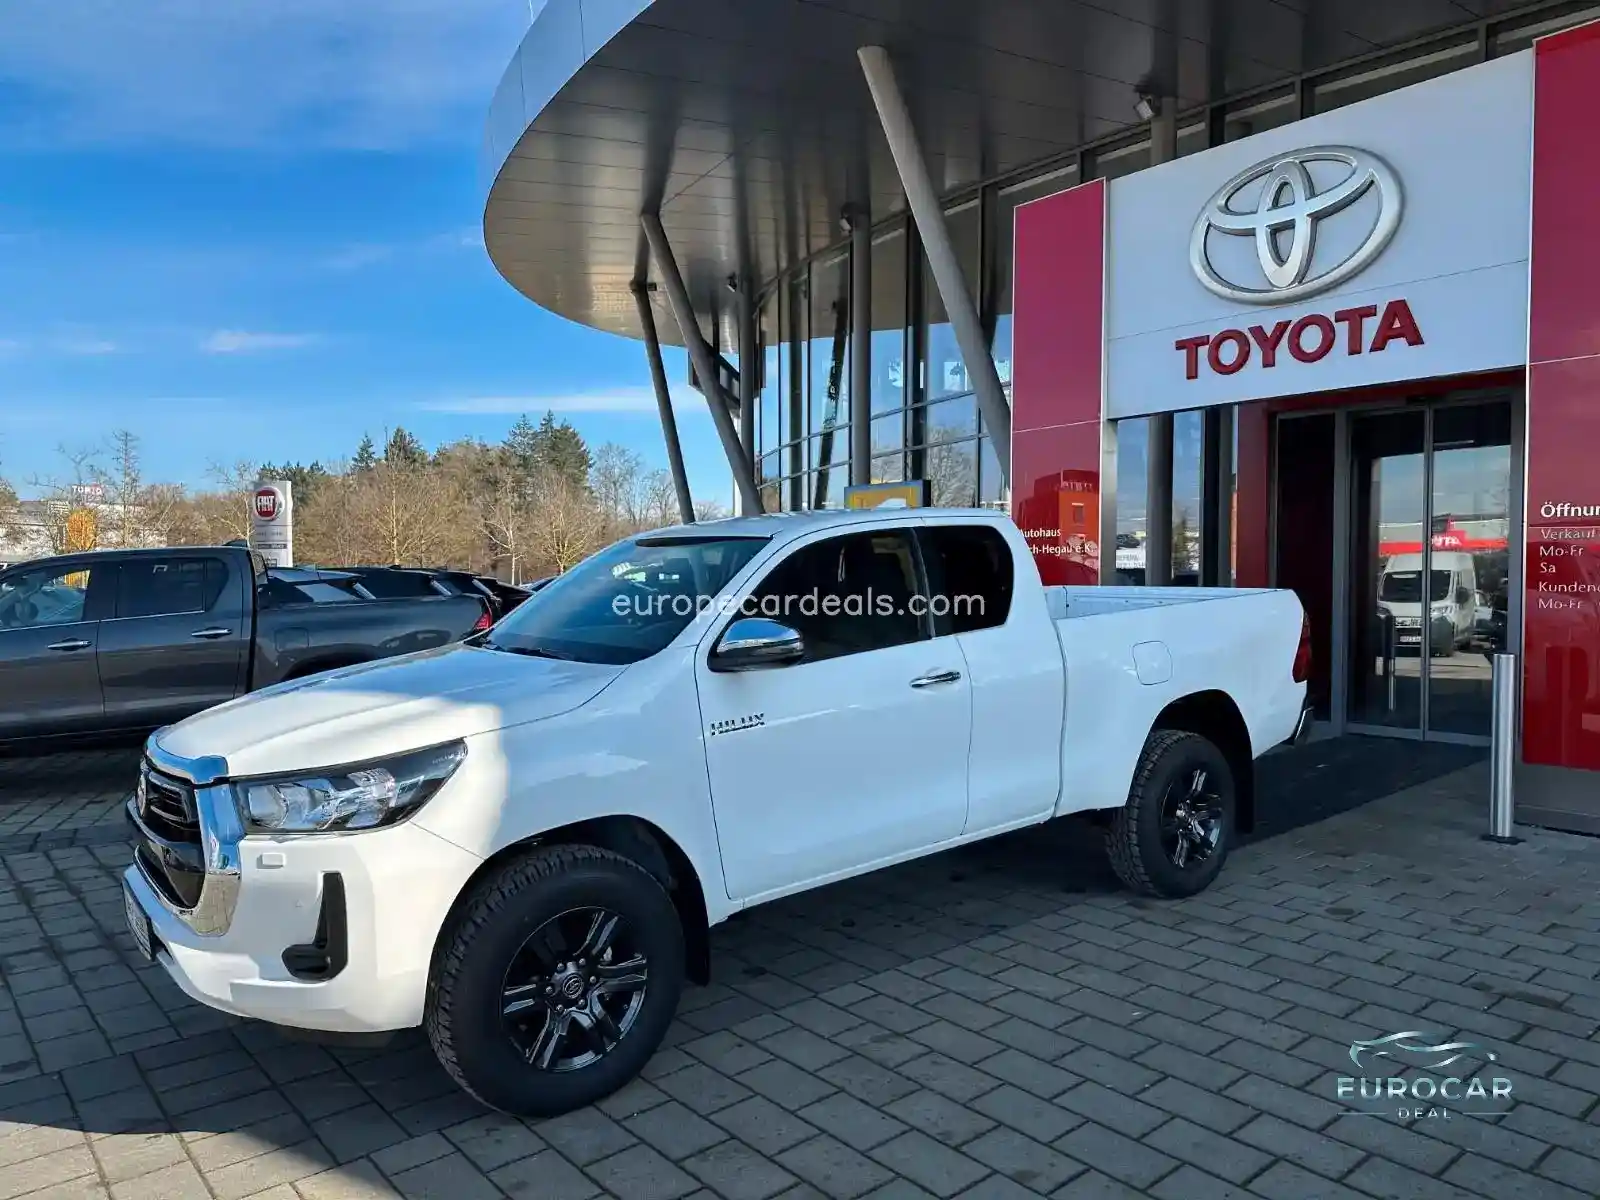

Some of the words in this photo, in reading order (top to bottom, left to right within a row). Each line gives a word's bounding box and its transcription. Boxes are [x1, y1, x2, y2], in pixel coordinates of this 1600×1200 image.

[1175, 299, 1424, 380] TOYOTA
[257, 496, 274, 512] FIAT
[1029, 543, 1072, 557] h-Hegau
[1540, 545, 1583, 556] Mo-Fr
[1540, 562, 1556, 573] Sa
[1538, 598, 1581, 609] Mo-Fr
[711, 712, 765, 736] HILUX
